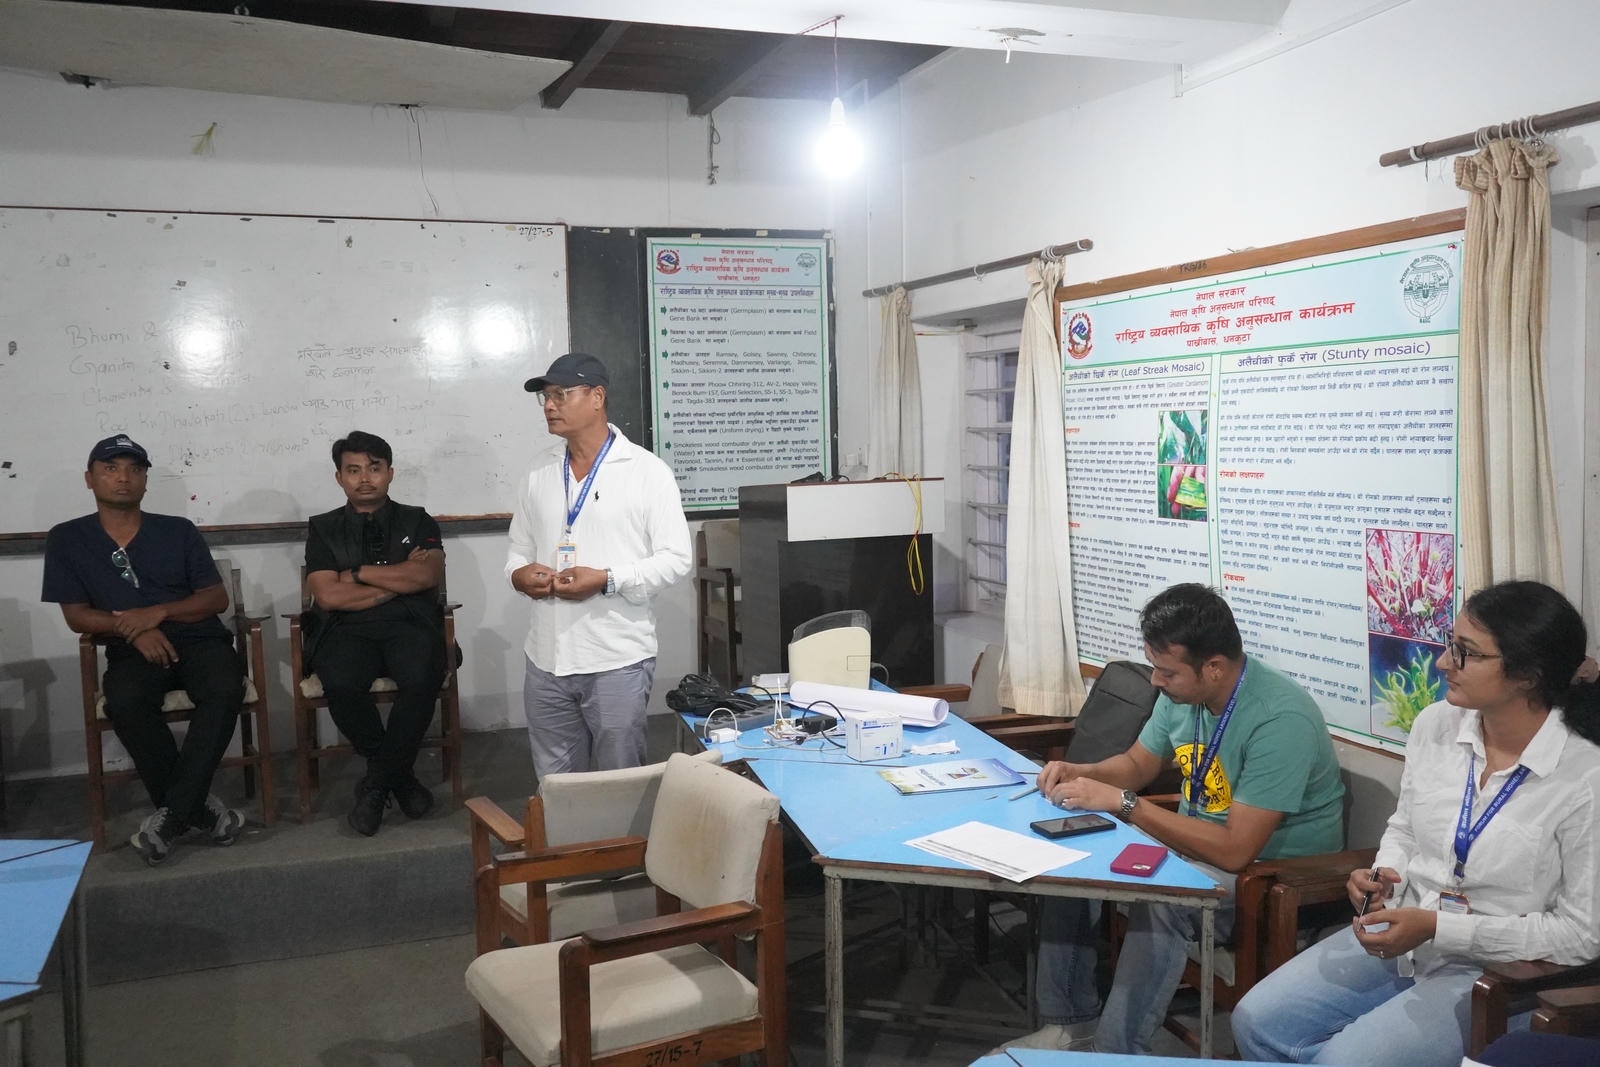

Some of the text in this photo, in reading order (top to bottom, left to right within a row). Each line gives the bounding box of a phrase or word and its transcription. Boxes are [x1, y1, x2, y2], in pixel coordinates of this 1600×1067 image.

[1196, 287, 1245, 302] नेपाल सरकार
[1170, 296, 1275, 319] नेपाल कृषि अनुसन्धान परिषद्
[1115, 301, 1355, 344] राष्ट्रिय व्यवसायिक कृषि अनुसन्धान कार्यक्रम
[1224, 333, 1251, 345] धनकुटा
[1300, 352, 1317, 363] रोग
[1322, 348, 1369, 364] (Stunty
[1373, 341, 1431, 357] mosaic)
[1121, 367, 1140, 378] (Leaf
[1143, 365, 1169, 375] Streak
[1171, 361, 1206, 373] Mosaic)
[1474, 815, 1487, 832] FORUM
[1486, 807, 1496, 817] FOR
[1494, 793, 1507, 808] RURAL
[1505, 776, 1520, 792] WOMEN
[646, 1040, 703, 1067] 27/15-7
